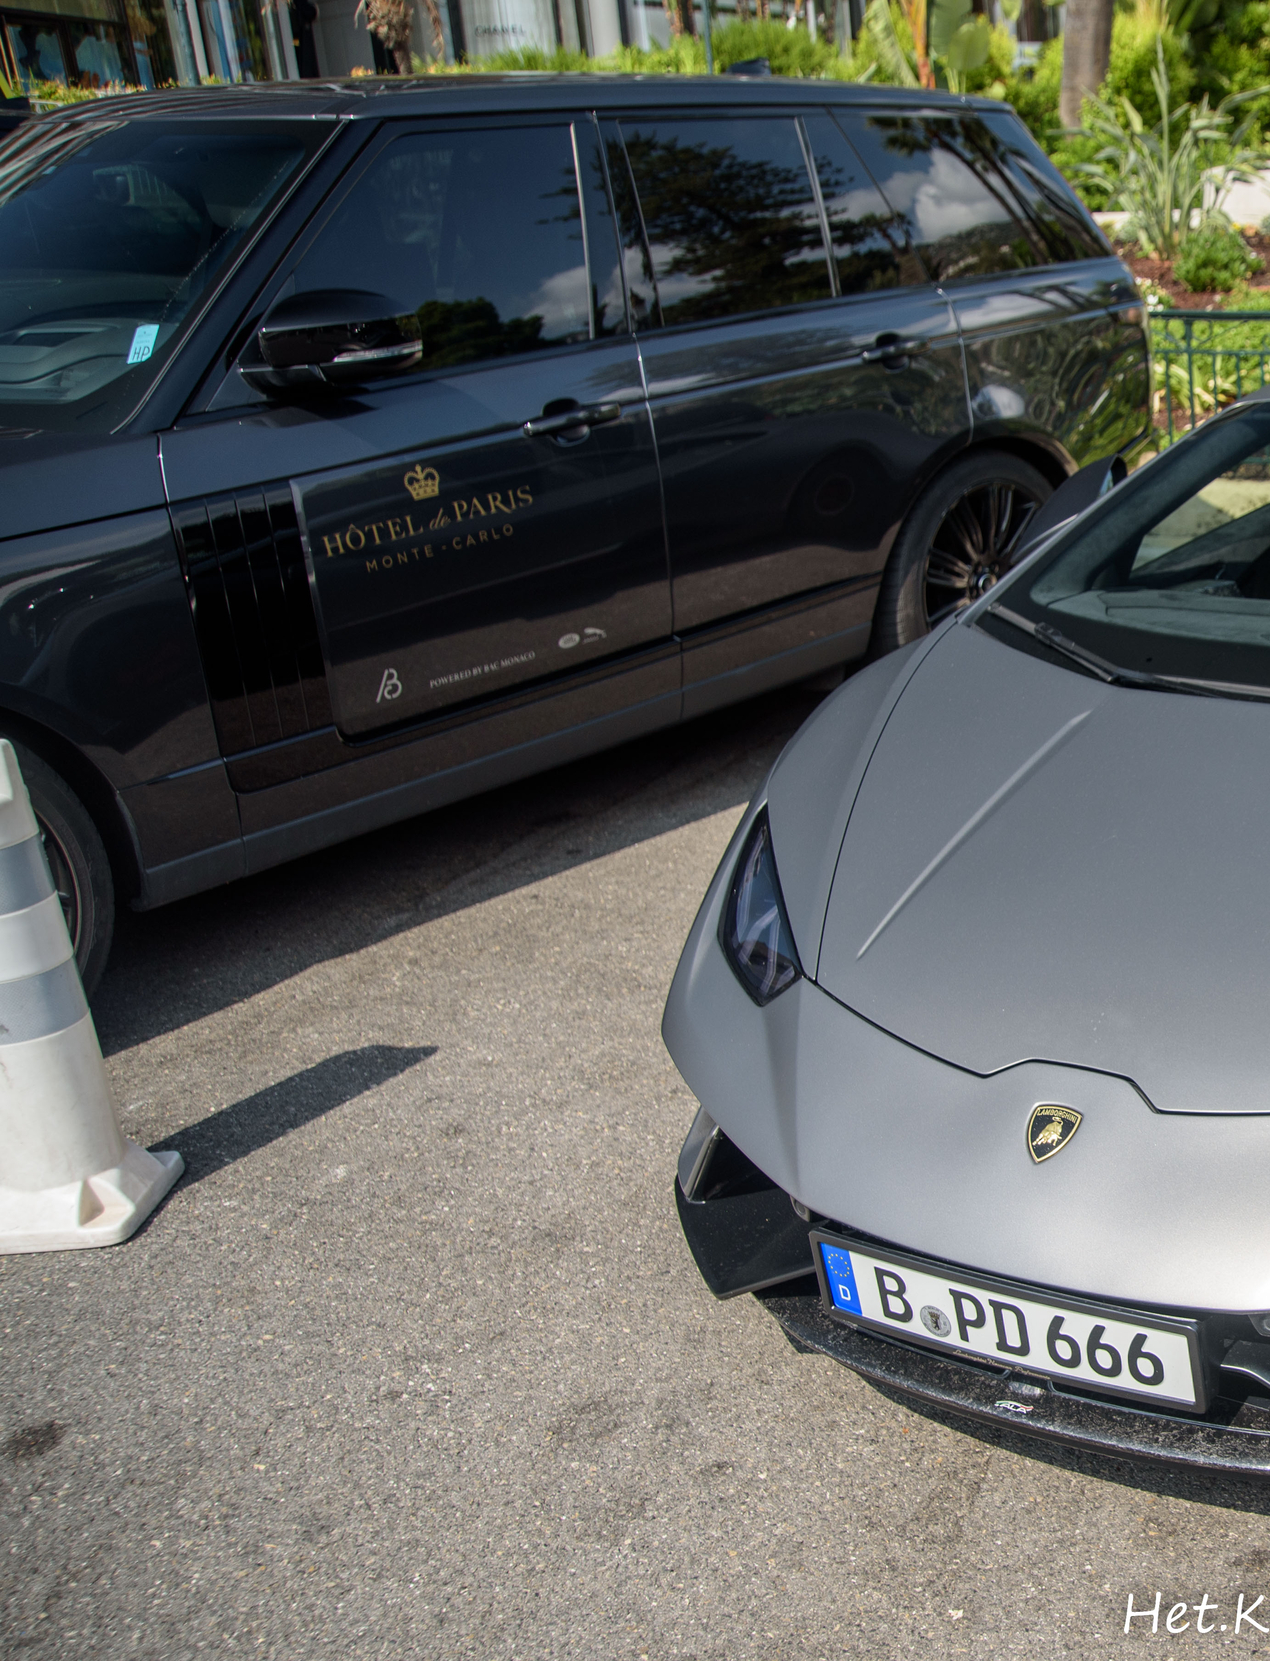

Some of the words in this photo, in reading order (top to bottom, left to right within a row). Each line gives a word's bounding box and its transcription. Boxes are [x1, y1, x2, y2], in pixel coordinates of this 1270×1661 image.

[321, 514, 424, 558] HÔTEL
[429, 507, 451, 531] de
[452, 485, 533, 522] PARIS
[429, 669, 472, 688] POWERED
[472, 666, 482, 676] BY
[483, 661, 499, 673] BAC
[500, 650, 536, 668] MONACO
[1036, 1109, 1078, 1123] LAMBORGHINI
[838, 1284, 851, 1301] D
[874, 1266, 914, 1323] B
[949, 1288, 1030, 1357] PD
[1046, 1315, 1165, 1386] 666
